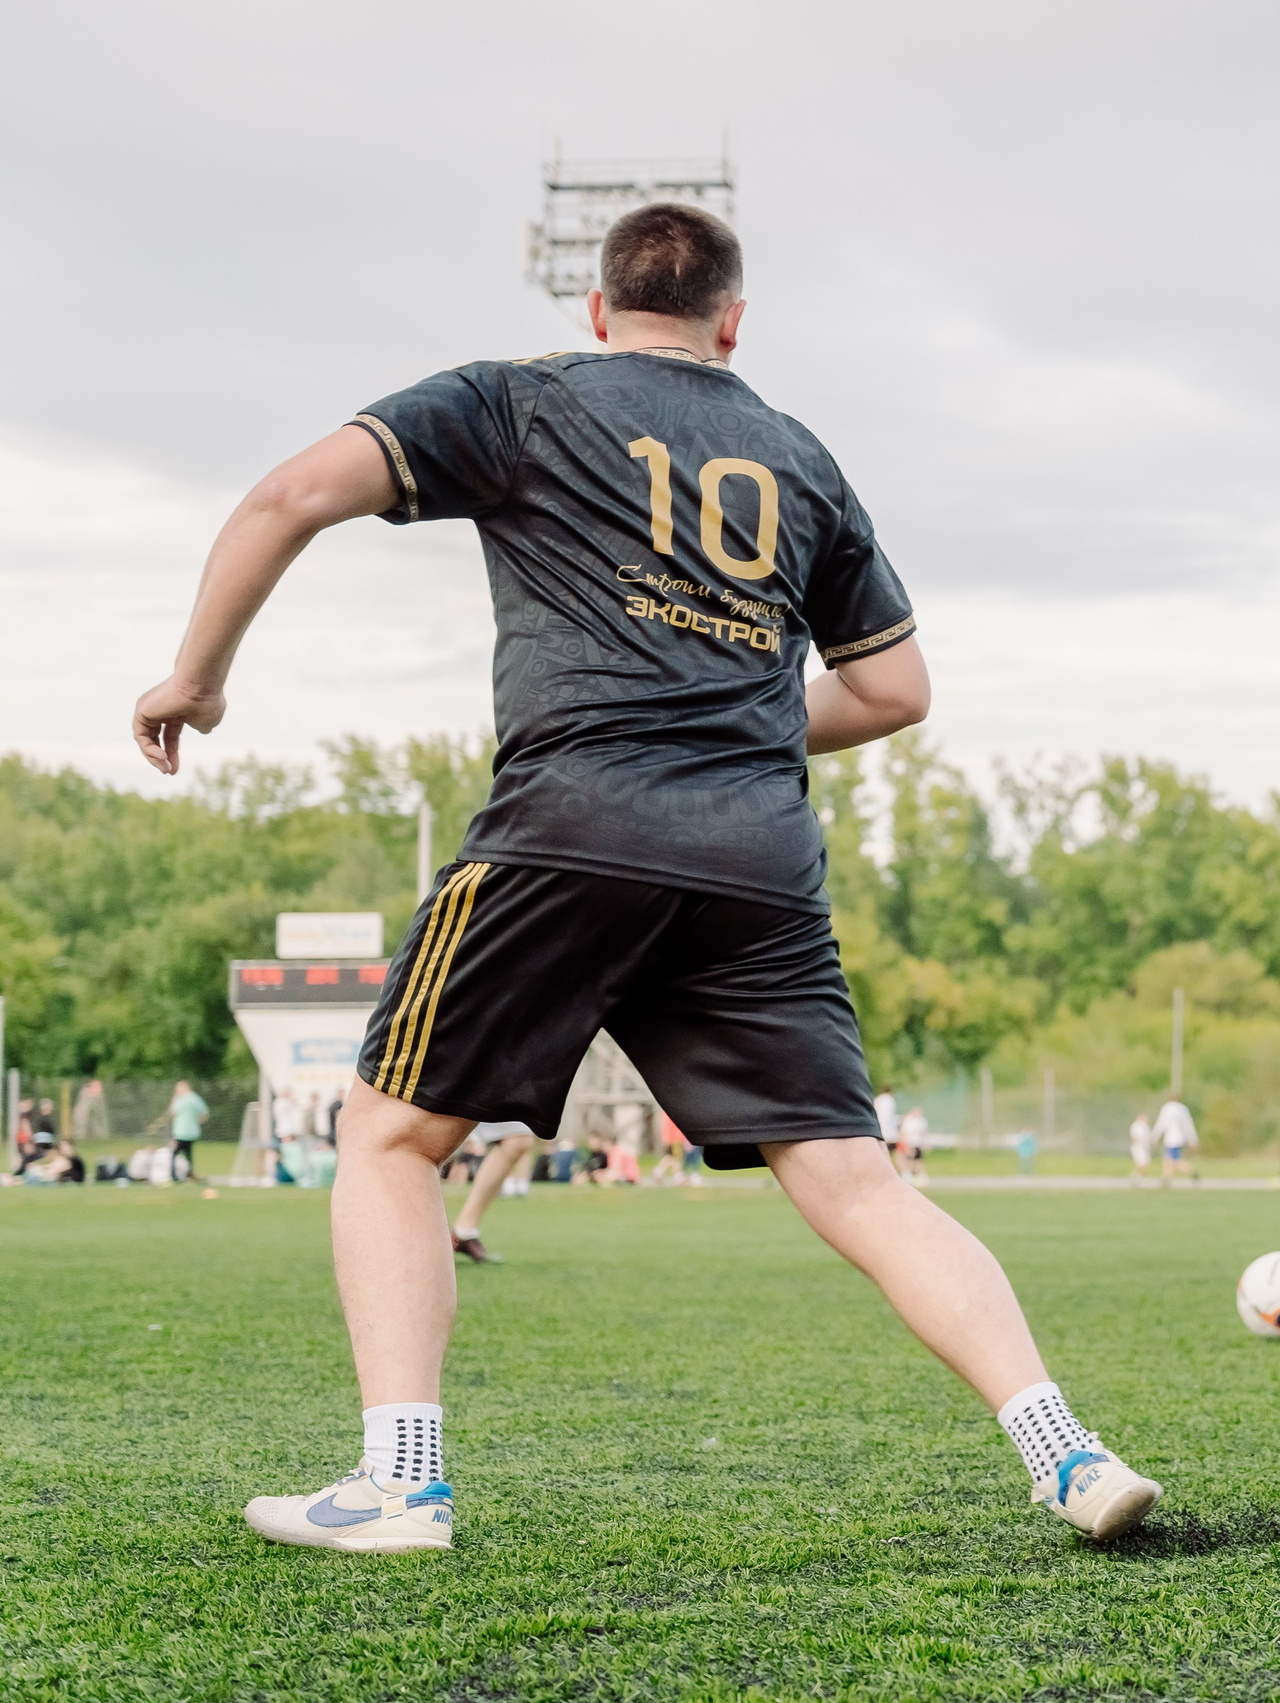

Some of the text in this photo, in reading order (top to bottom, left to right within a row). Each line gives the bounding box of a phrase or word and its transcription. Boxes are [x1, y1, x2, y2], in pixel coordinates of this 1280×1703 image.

[628, 436, 779, 580] 10
[616, 563, 711, 598] Строим
[625, 595, 781, 655] ЭКОСТРОЙ
[1075, 1465, 1103, 1497] NIKE
[431, 1508, 453, 1527] NIK
